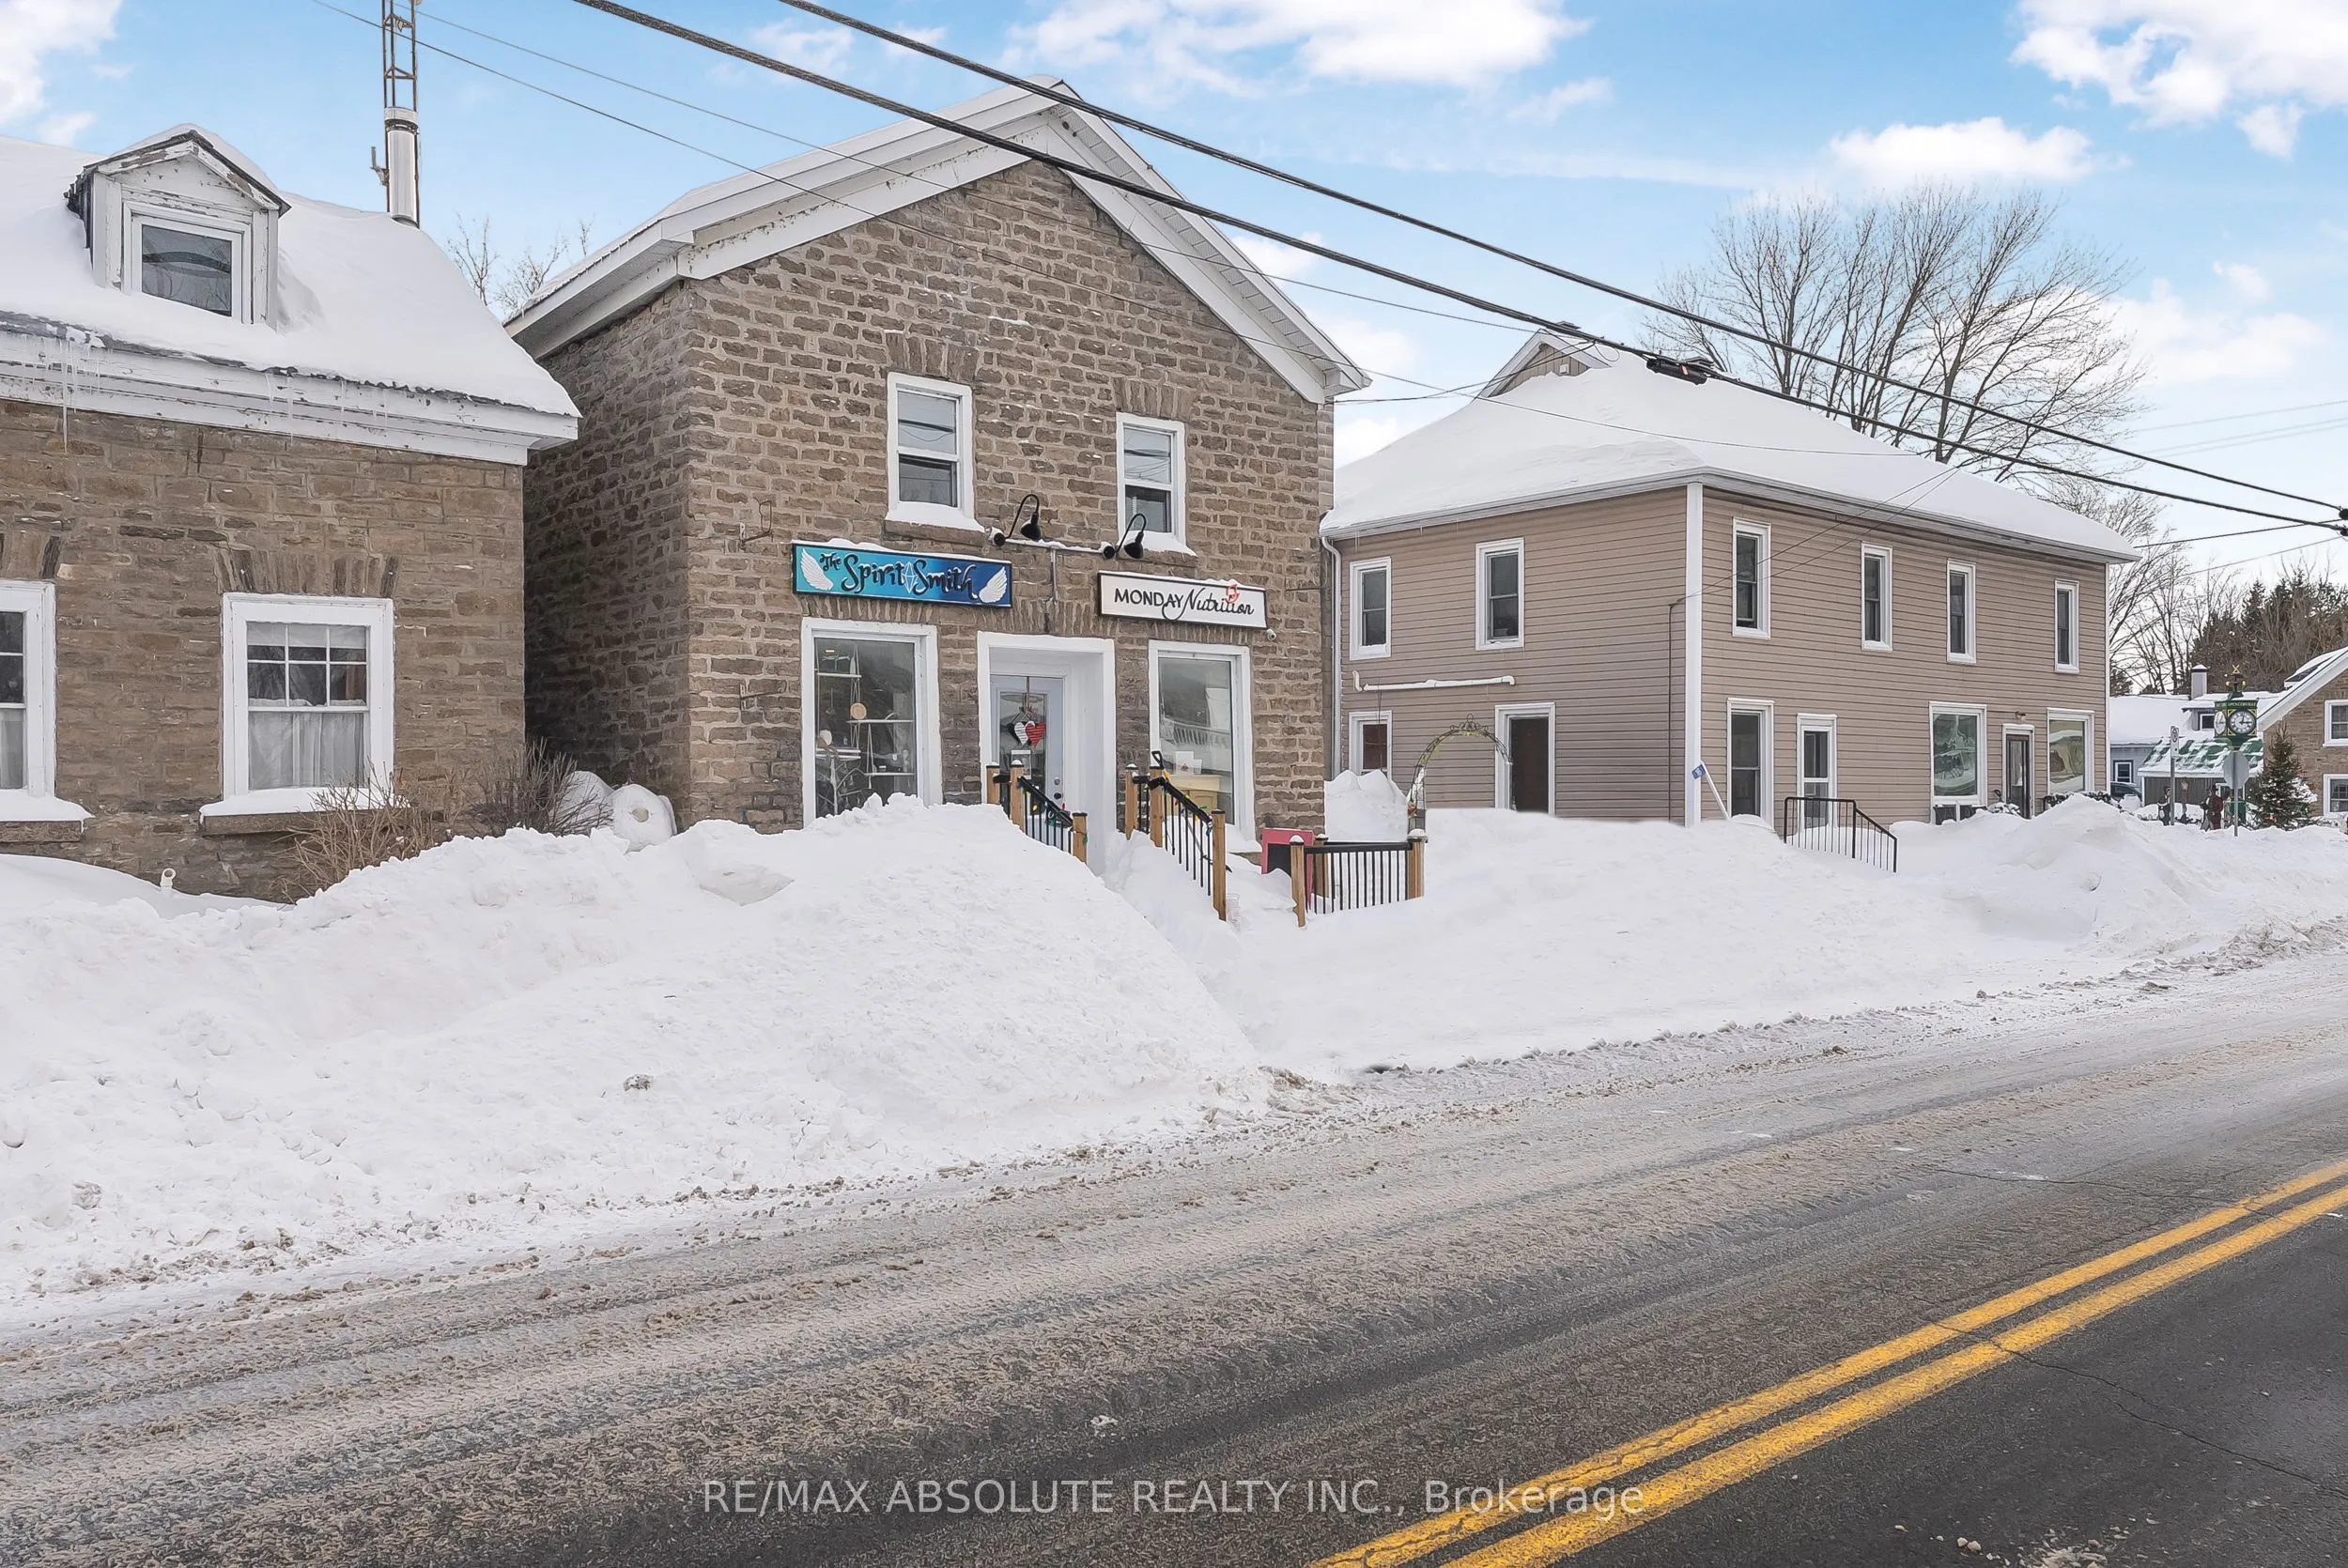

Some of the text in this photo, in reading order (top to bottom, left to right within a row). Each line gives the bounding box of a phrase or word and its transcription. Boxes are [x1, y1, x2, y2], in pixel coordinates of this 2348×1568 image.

[820, 551, 979, 599] The Spirit Smith
[1114, 587, 1255, 621] MONDAY Nutrition
